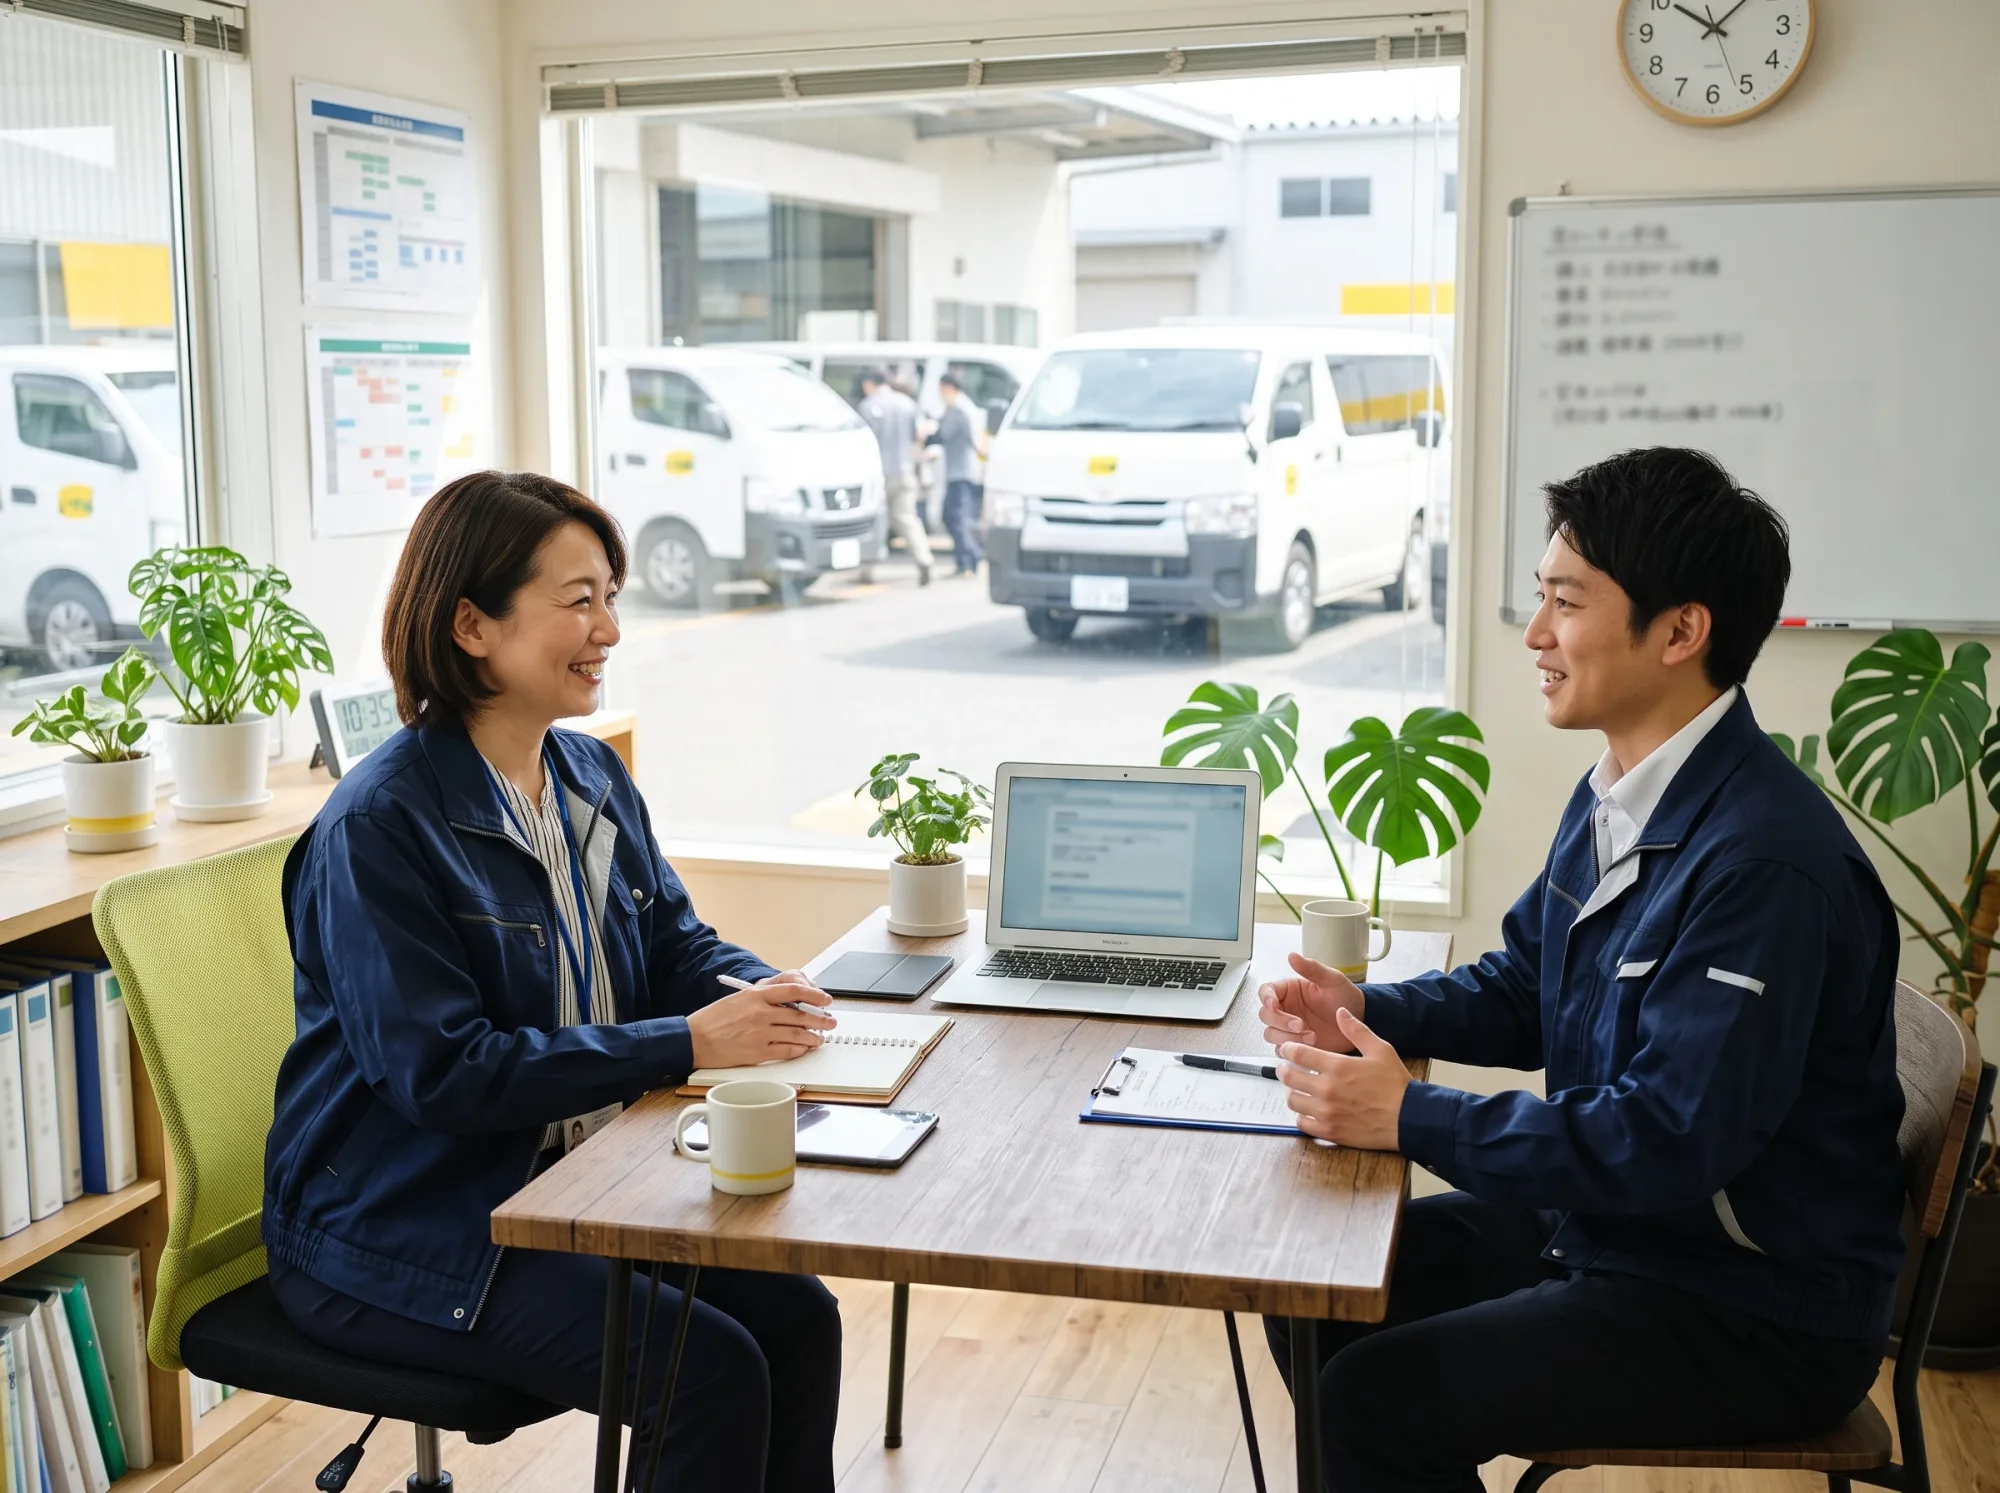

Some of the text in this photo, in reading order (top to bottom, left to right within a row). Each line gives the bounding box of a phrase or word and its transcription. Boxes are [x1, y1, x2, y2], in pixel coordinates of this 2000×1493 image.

[1639, 23, 1654, 43] 9
[1775, 14, 1791, 36] 3
[1649, 55, 1663, 75] 8
[1765, 49, 1780, 69] 4
[1674, 77, 1688, 97] 7
[1706, 84, 1720, 104] 6
[1739, 74, 1753, 95] 5
[342, 694, 394, 733] 10:35
